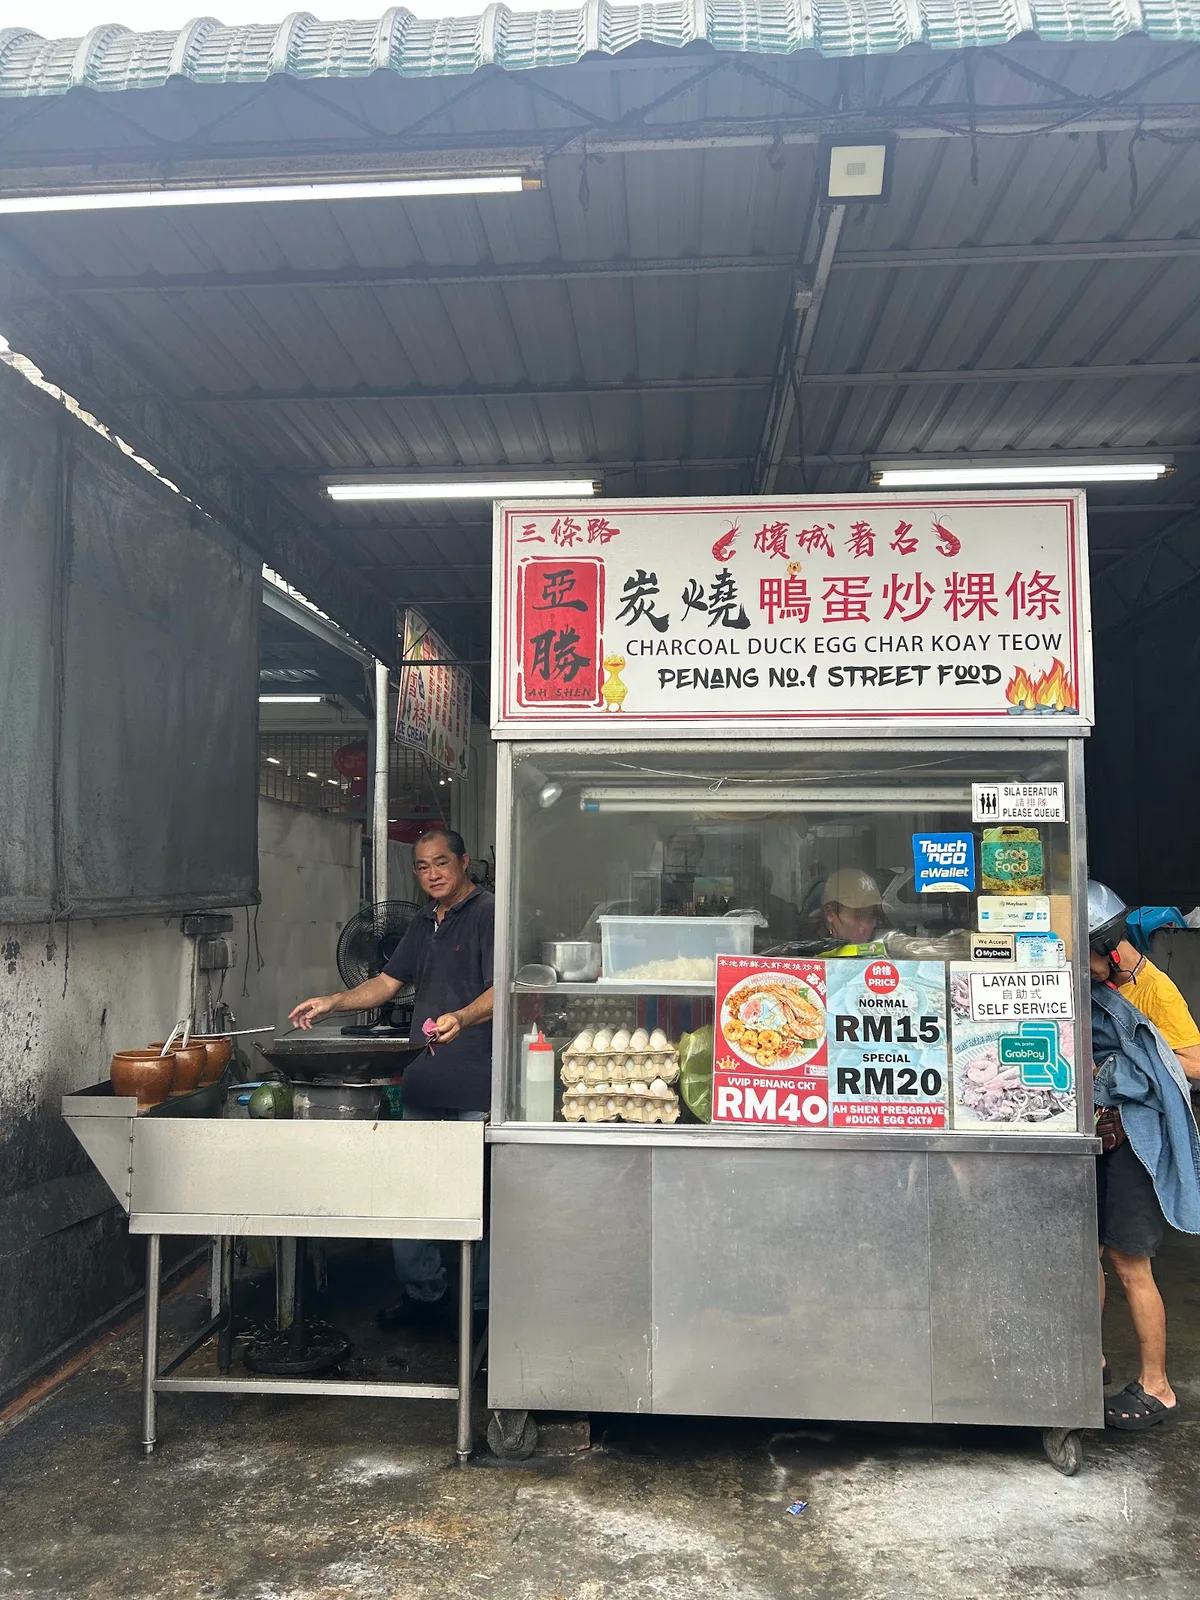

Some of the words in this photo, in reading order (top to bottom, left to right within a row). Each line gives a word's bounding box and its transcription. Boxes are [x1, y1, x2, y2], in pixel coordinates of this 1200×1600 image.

[516, 516, 621, 548] 三條路
[753, 519, 919, 560] 檳城著名
[529, 568, 592, 683] 亞勝
[626, 638, 741, 656] CHARCOAL
[748, 637, 807, 655] DUCK
[814, 636, 857, 654] EGG
[864, 635, 924, 653] CHAR
[931, 634, 992, 652] KOAY
[998, 633, 1063, 651] TEOW
[657, 666, 760, 690] PENANG
[828, 664, 932, 688] STREET
[528, 688, 548, 698] AH
[556, 687, 592, 697] SHEN
[1003, 786, 1021, 797] SILA
[1022, 786, 1058, 797] BERATUR
[1002, 808, 1033, 818] PLEASE
[1034, 808, 1060, 818] QUEUE
[919, 839, 968, 854] Touch
[994, 847, 1029, 861] Grab
[920, 866, 970, 878] eWallet
[995, 860, 1030, 874] Food
[983, 949, 1011, 958] MyDebit
[871, 965, 892, 976] 价格
[868, 978, 896, 987] PRICE
[982, 974, 1027, 987] LAYAN
[1031, 974, 1060, 986] DIRI
[1002, 988, 1042, 1000] 自助式
[859, 998, 909, 1008] NORMAL
[977, 1003, 1010, 1015] SELF
[1013, 1002, 1068, 1015] SERVICE
[835, 1015, 941, 1044] RM15
[862, 1053, 911, 1063] SPECIAL
[1004, 1049, 1046, 1060] GrabPay
[727, 1077, 752, 1086] VVIP
[752, 1078, 796, 1089] PENANG
[797, 1081, 817, 1091] CKT
[836, 1067, 942, 1096] RM20
[717, 1086, 828, 1124] RM40
[833, 1104, 848, 1114] AH
[849, 1105, 879, 1115] SHEN
[881, 1106, 945, 1115] PRESGRAVE
[845, 1115, 880, 1124] #DUCK
[883, 1116, 905, 1125] EGG
[907, 1116, 933, 1125] CKT#
